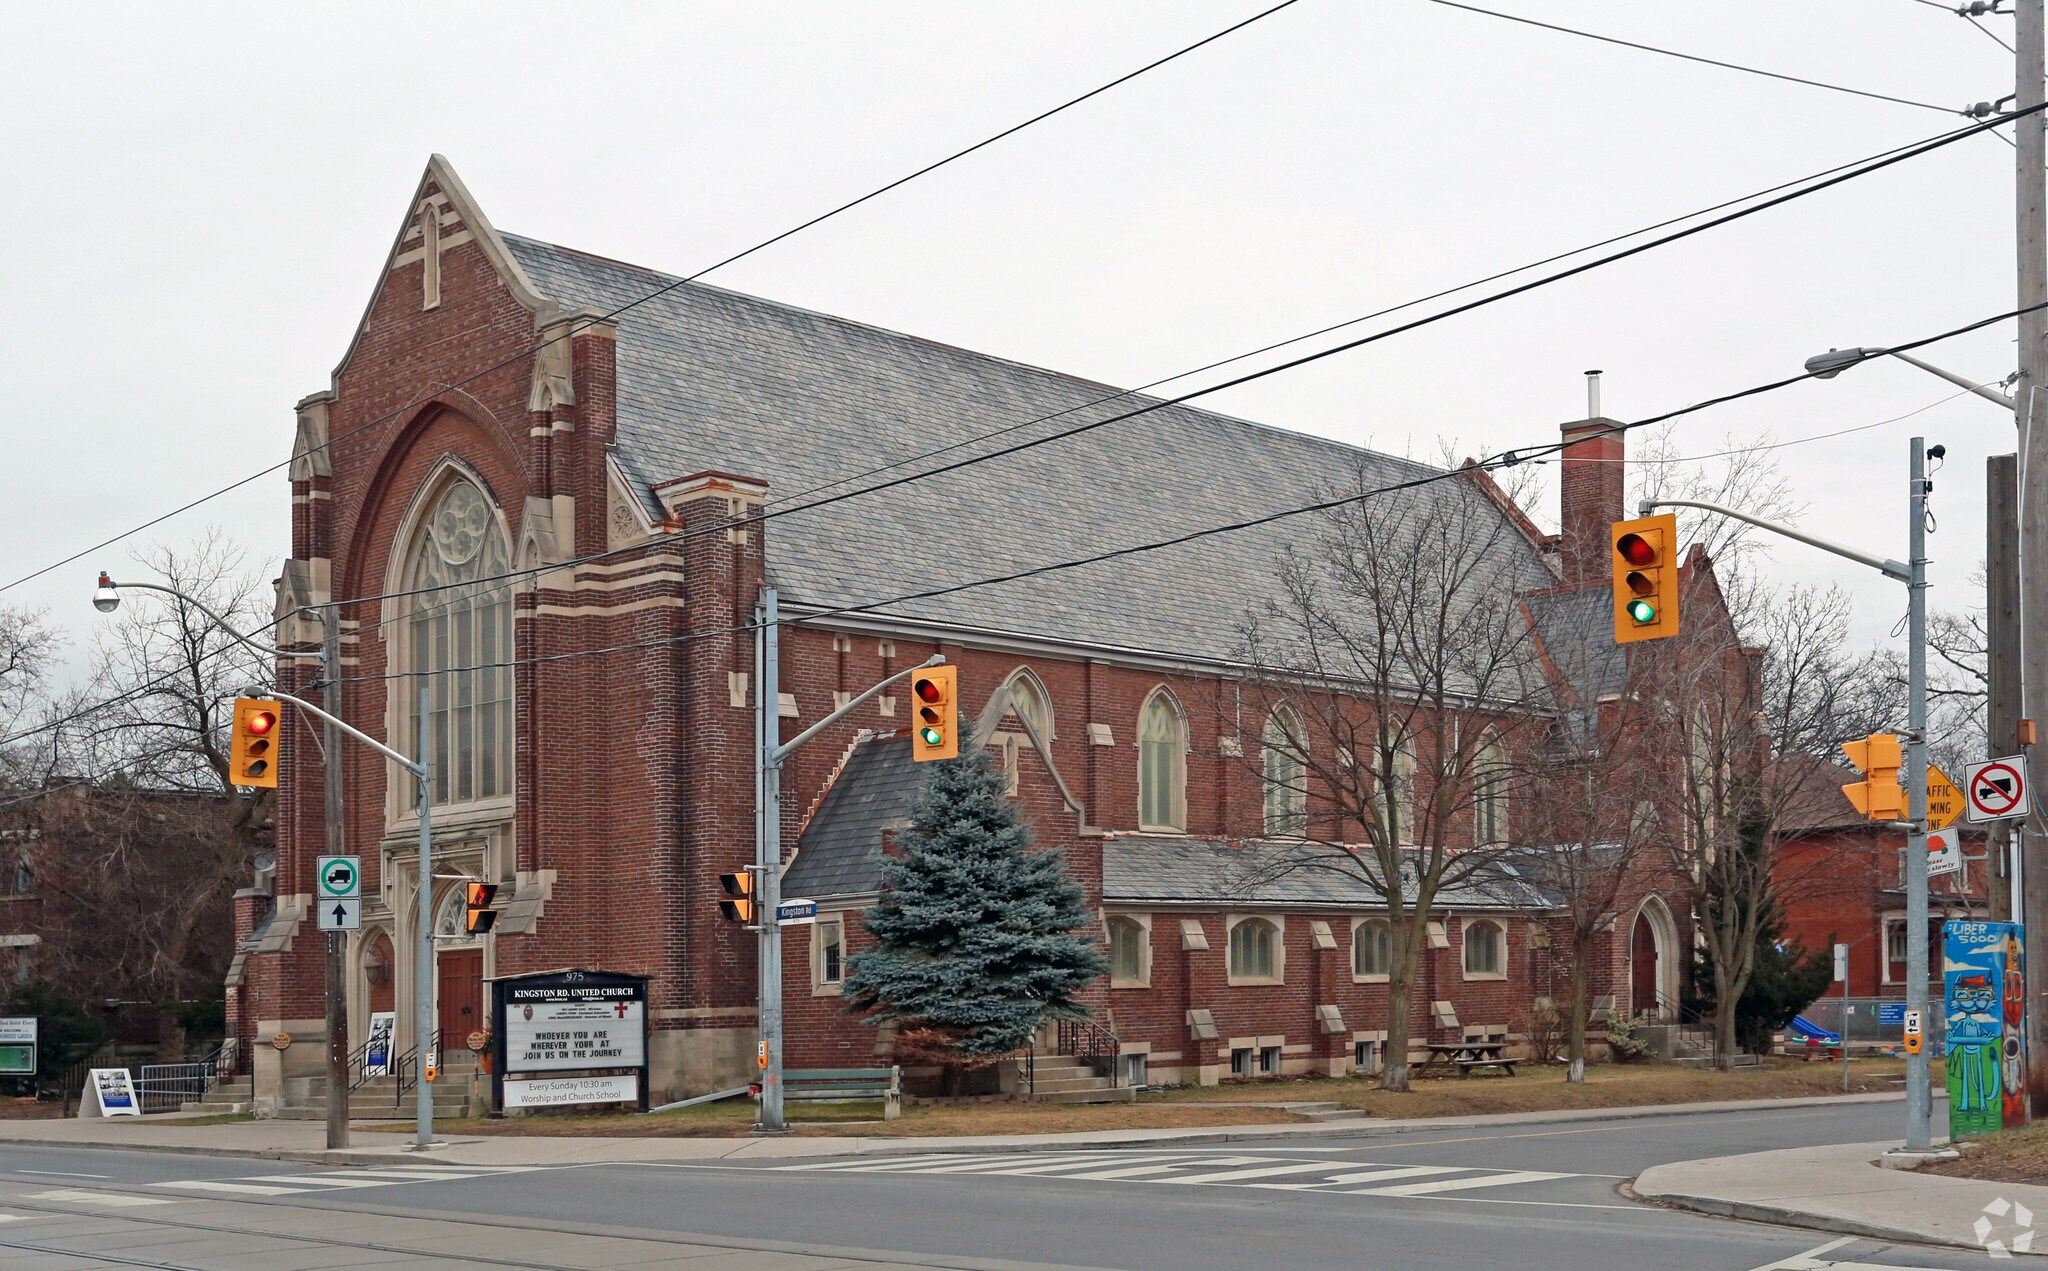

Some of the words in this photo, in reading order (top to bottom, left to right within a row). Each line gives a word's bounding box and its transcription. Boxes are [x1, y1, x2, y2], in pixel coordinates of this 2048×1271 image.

[1926, 785, 1951, 797] AFFIC
[1927, 802, 1951, 814] MING
[1926, 819, 1942, 831] ONE
[1932, 862, 1955, 871] slowly
[781, 906, 805, 918] Kingston
[805, 906, 812, 914] Rd
[1958, 934, 1997, 944] 5000
[566, 972, 584, 982] 975
[514, 989, 556, 998] KINGSTON
[557, 989, 570, 997] RD.
[571, 988, 600, 996] UNITED
[601, 987, 634, 996] CHURCH
[535, 1032, 570, 1040] WHOEVER
[573, 1031, 588, 1039] YOU
[593, 1030, 607, 1038] ARE
[530, 1041, 567, 1050] WHEREVER
[574, 1040, 594, 1049] YOUR
[600, 1039, 610, 1048] AT
[523, 1052, 541, 1060] JOIN
[545, 1051, 555, 1059] US
[560, 1050, 569, 1058] ON
[572, 1050, 586, 1058] THE
[589, 1048, 622, 1057] JOURNEY
[528, 1083, 549, 1092] Every
[551, 1081, 578, 1090] Sunday
[580, 1080, 599, 1089] 10:30
[600, 1080, 612, 1088] am
[520, 1094, 552, 1103] Worship
[552, 1093, 567, 1101] and
[568, 1091, 595, 1100] Church
[596, 1090, 621, 1099] School
